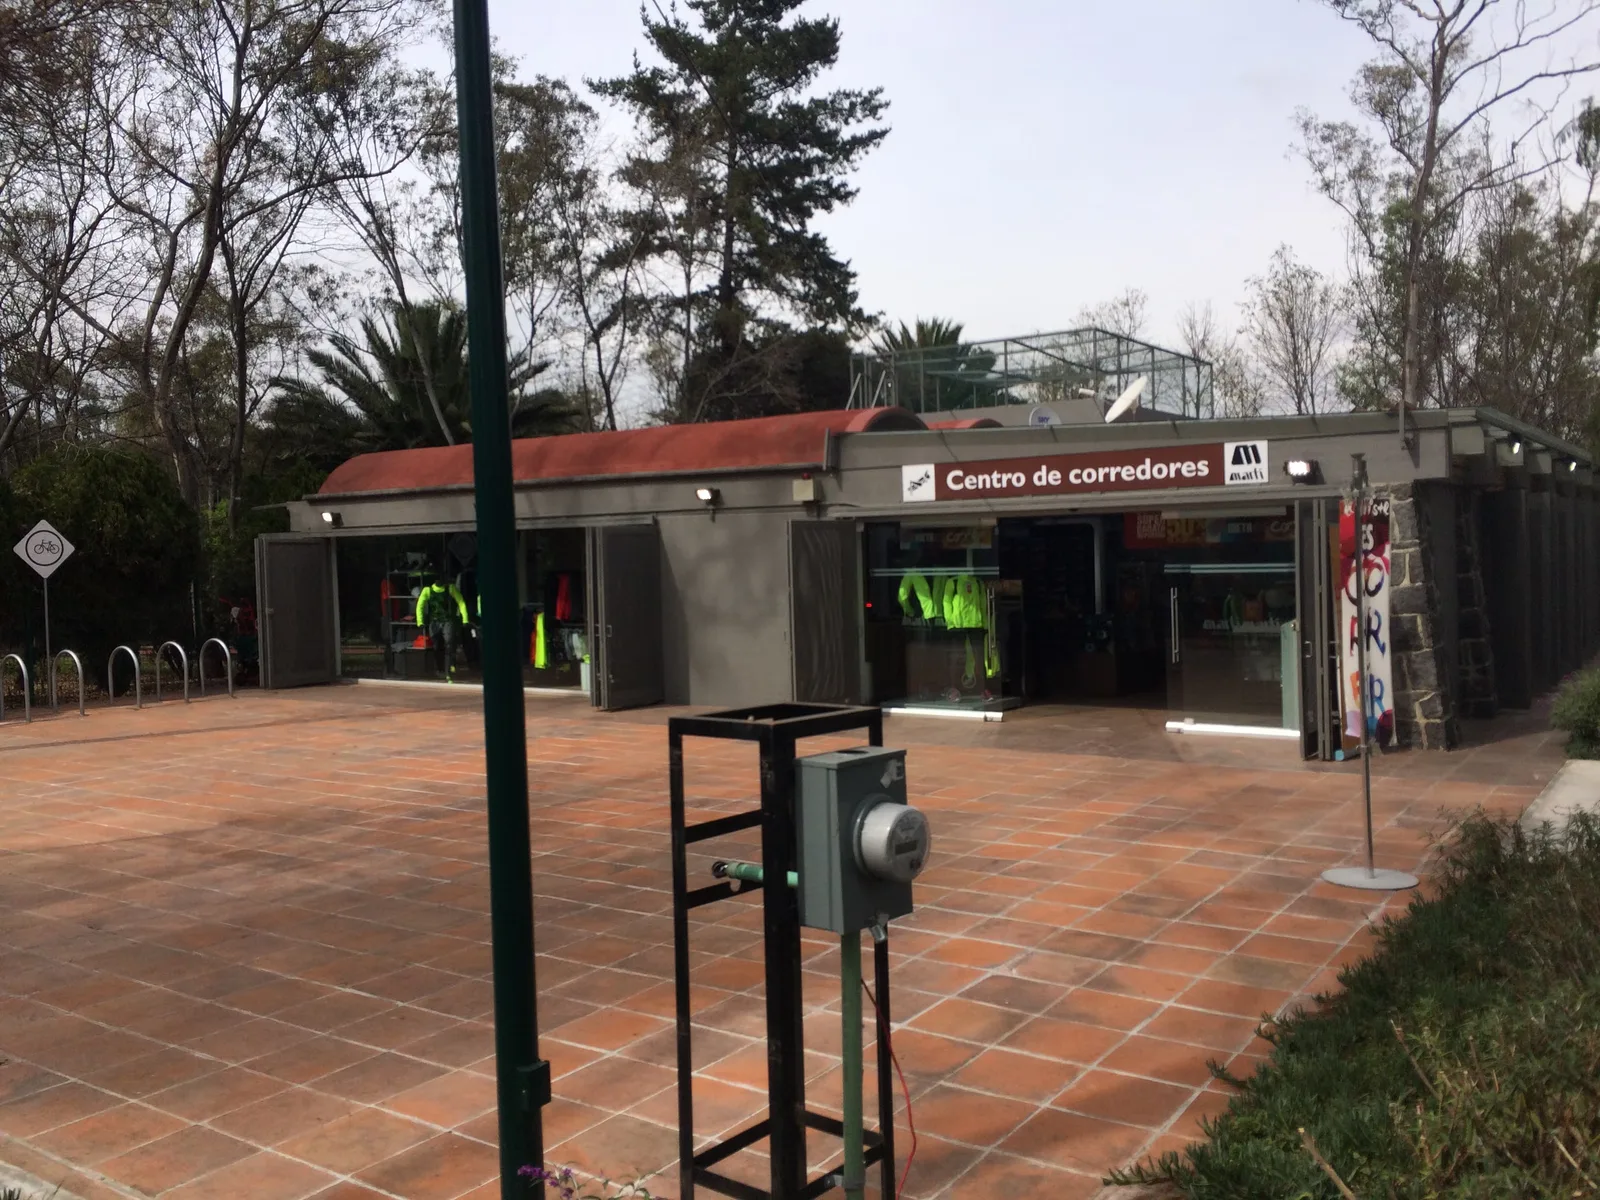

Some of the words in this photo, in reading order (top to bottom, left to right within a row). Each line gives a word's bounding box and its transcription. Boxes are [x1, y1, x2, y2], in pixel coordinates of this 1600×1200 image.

[946, 468, 1026, 491] Centro
[1032, 465, 1062, 486] de
[1068, 458, 1209, 484] corredores
